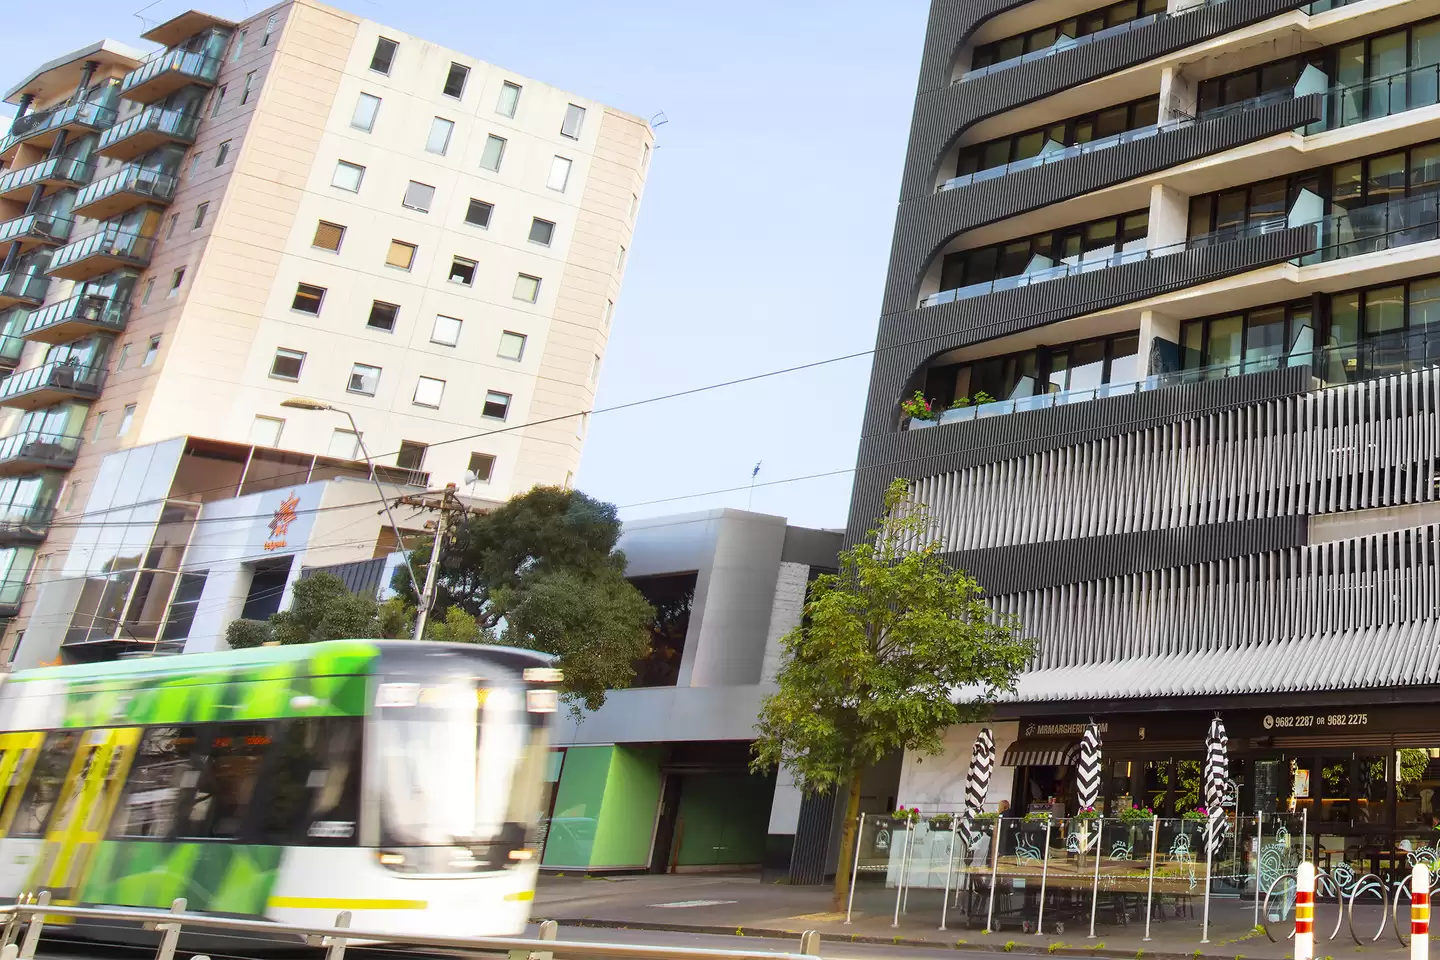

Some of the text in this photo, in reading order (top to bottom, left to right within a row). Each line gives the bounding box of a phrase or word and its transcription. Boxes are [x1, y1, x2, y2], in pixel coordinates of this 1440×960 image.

[1275, 714, 1368, 727] 9682 2287 OR 9682 2275
[1037, 723, 1109, 735] MRMARGHERITOM
